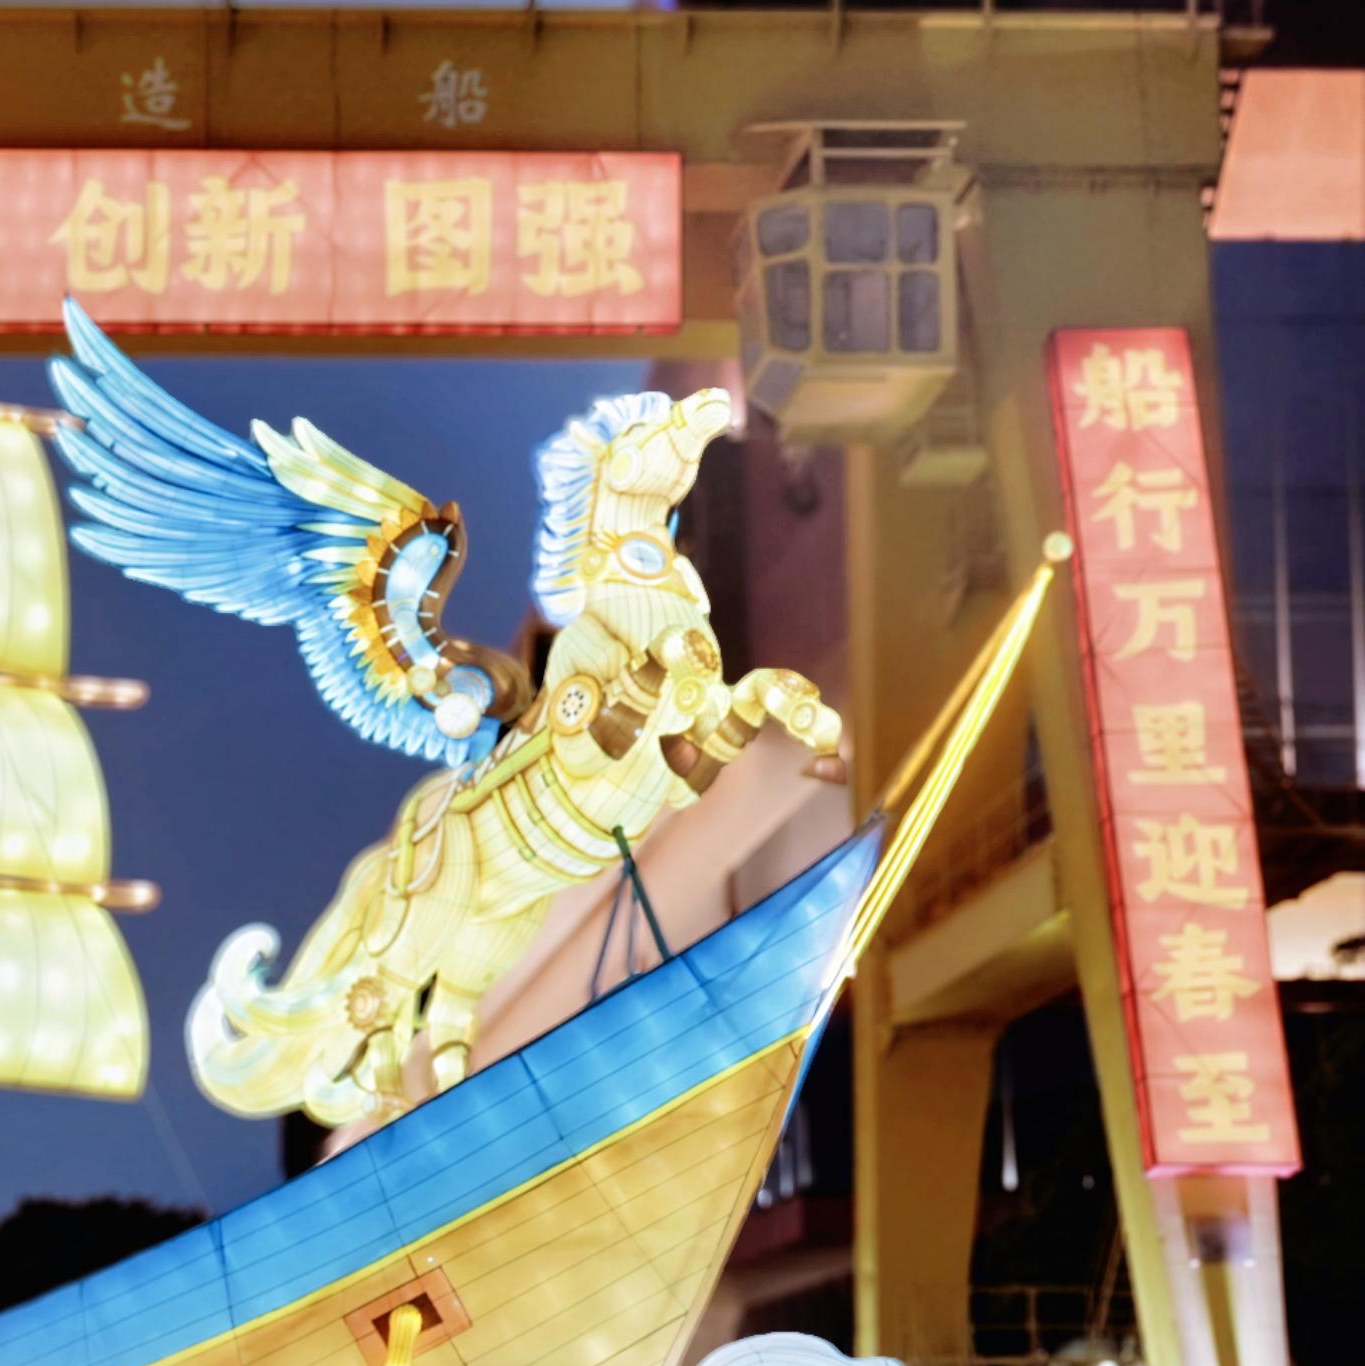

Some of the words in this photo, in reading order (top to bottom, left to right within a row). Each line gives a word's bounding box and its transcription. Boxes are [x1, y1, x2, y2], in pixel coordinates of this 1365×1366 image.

[52, 175, 307, 298] 创新
[381, 176, 646, 299] 图强
[1074, 343, 1271, 1146] 船行万里迎春至
